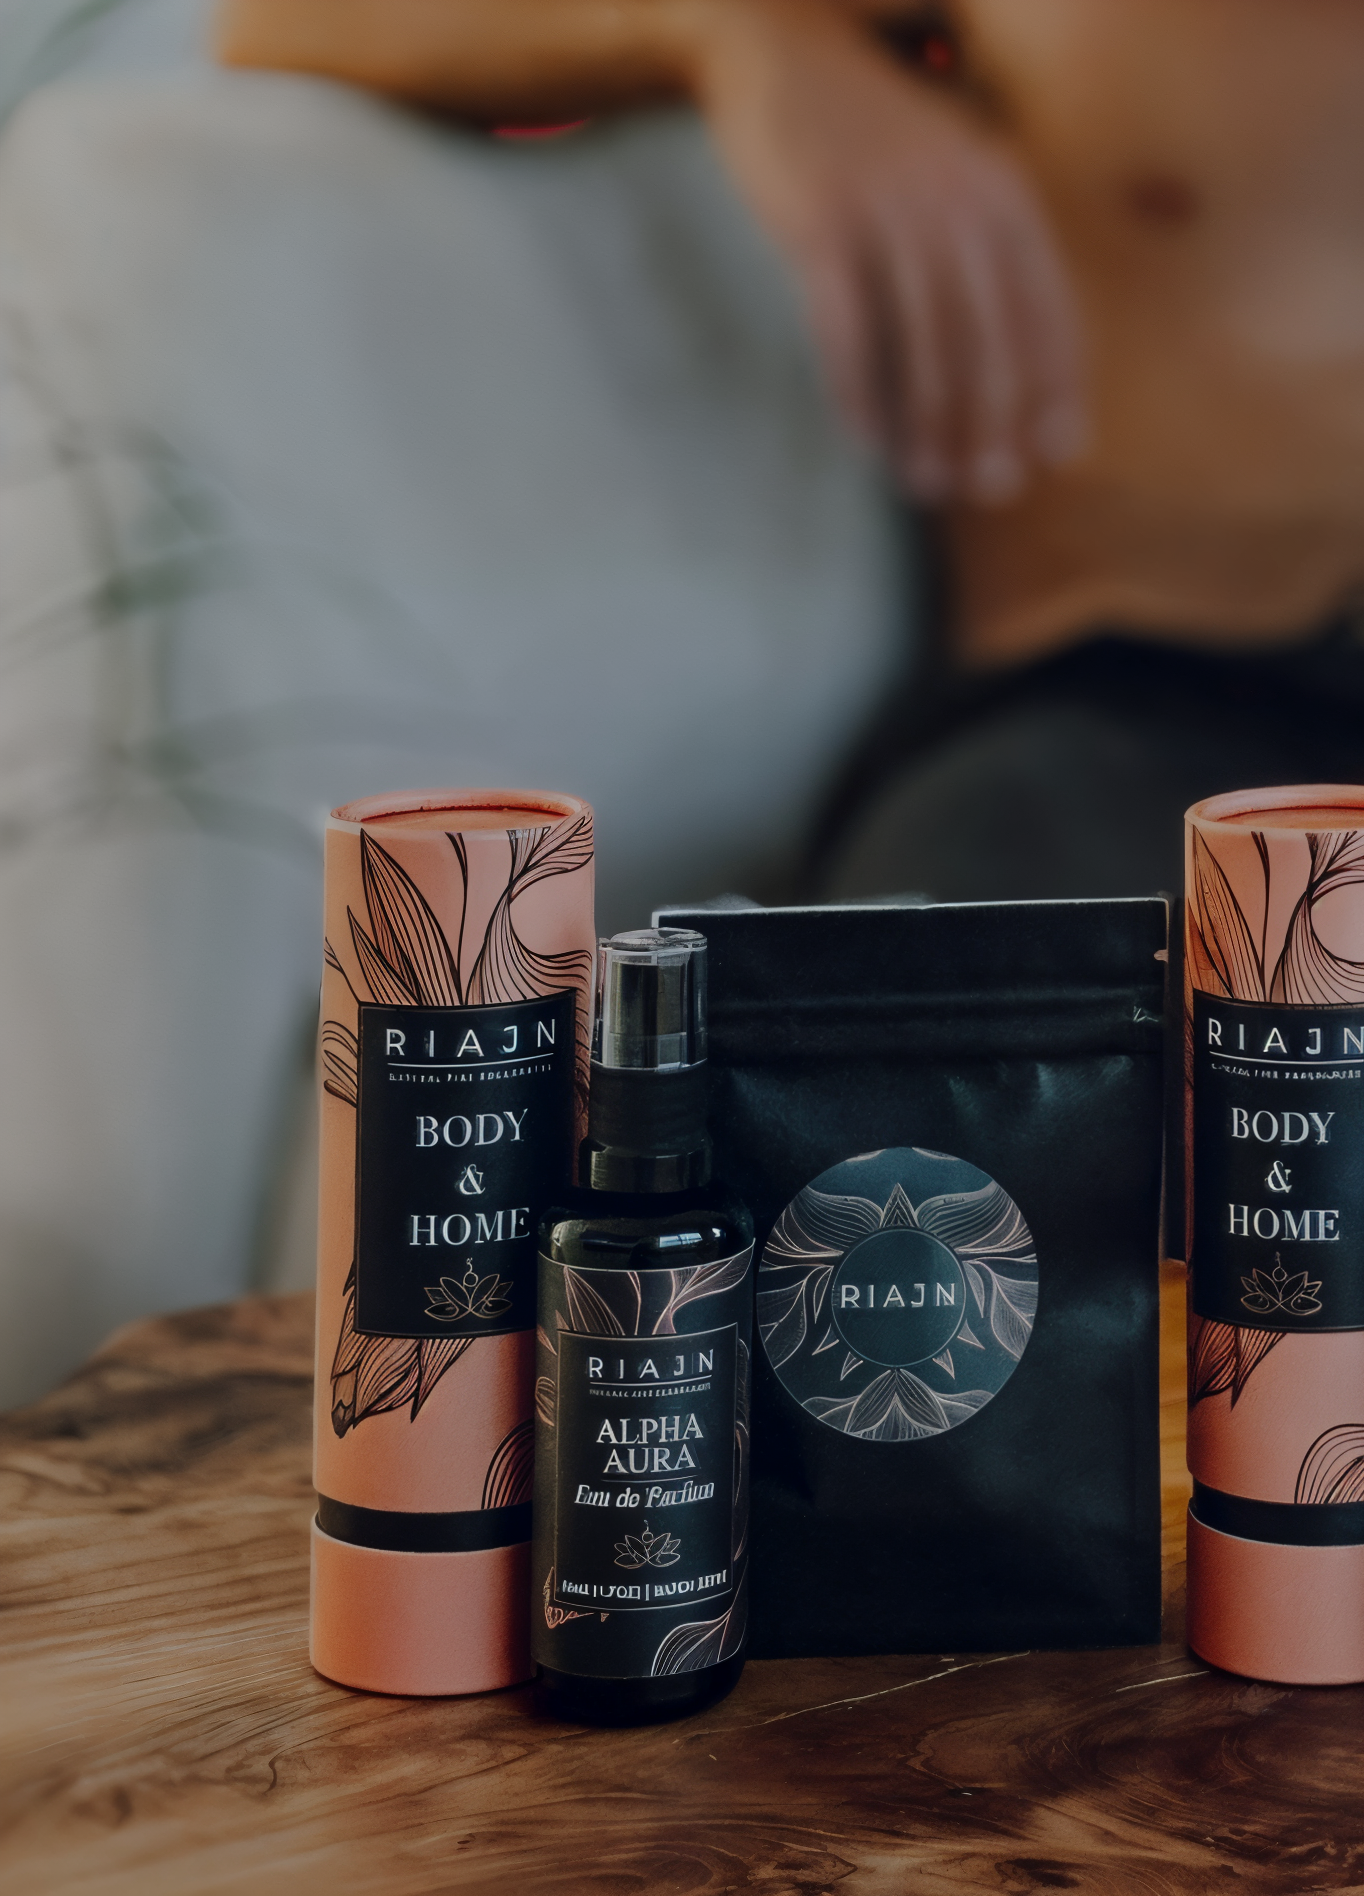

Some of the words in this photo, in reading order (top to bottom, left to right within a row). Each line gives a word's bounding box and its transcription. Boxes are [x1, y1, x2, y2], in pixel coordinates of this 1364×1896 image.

[386, 1018, 555, 1058] RIAJN
[416, 1108, 528, 1147] BODY
[1231, 1106, 1335, 1145] BODY
[458, 1163, 486, 1195] &
[1266, 1160, 1293, 1194] &
[408, 1207, 530, 1247] HOME
[1228, 1203, 1340, 1242] HOME
[840, 1282, 956, 1309] RIAJN
[588, 1348, 715, 1379] RIAJN
[596, 1412, 704, 1444] ALPHA
[602, 1443, 697, 1474] AURA
